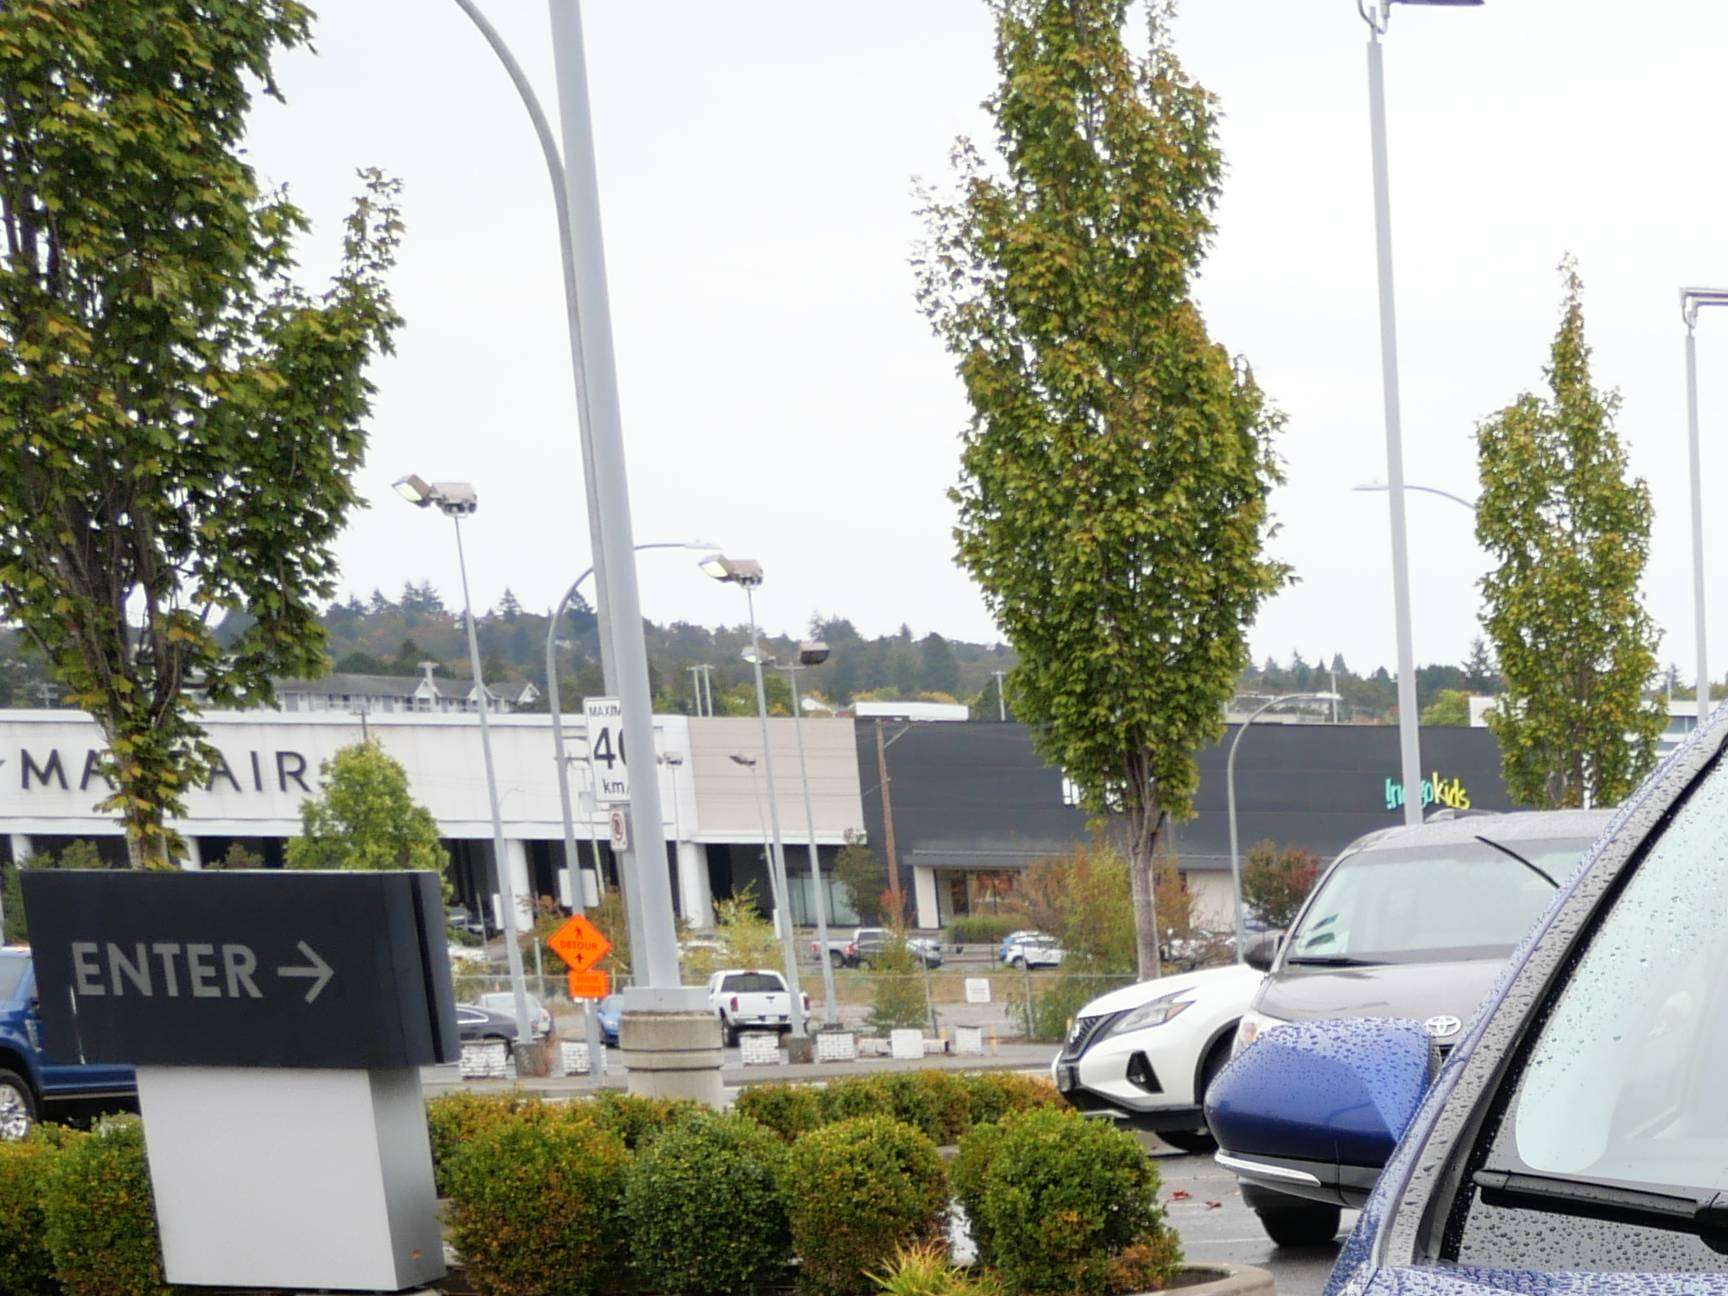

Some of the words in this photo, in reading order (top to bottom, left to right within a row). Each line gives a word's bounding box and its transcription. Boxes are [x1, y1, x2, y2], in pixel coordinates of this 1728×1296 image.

[20, 748, 313, 793] MAAIR
[593, 727, 627, 770] 4
[71, 942, 264, 999] ENTER
